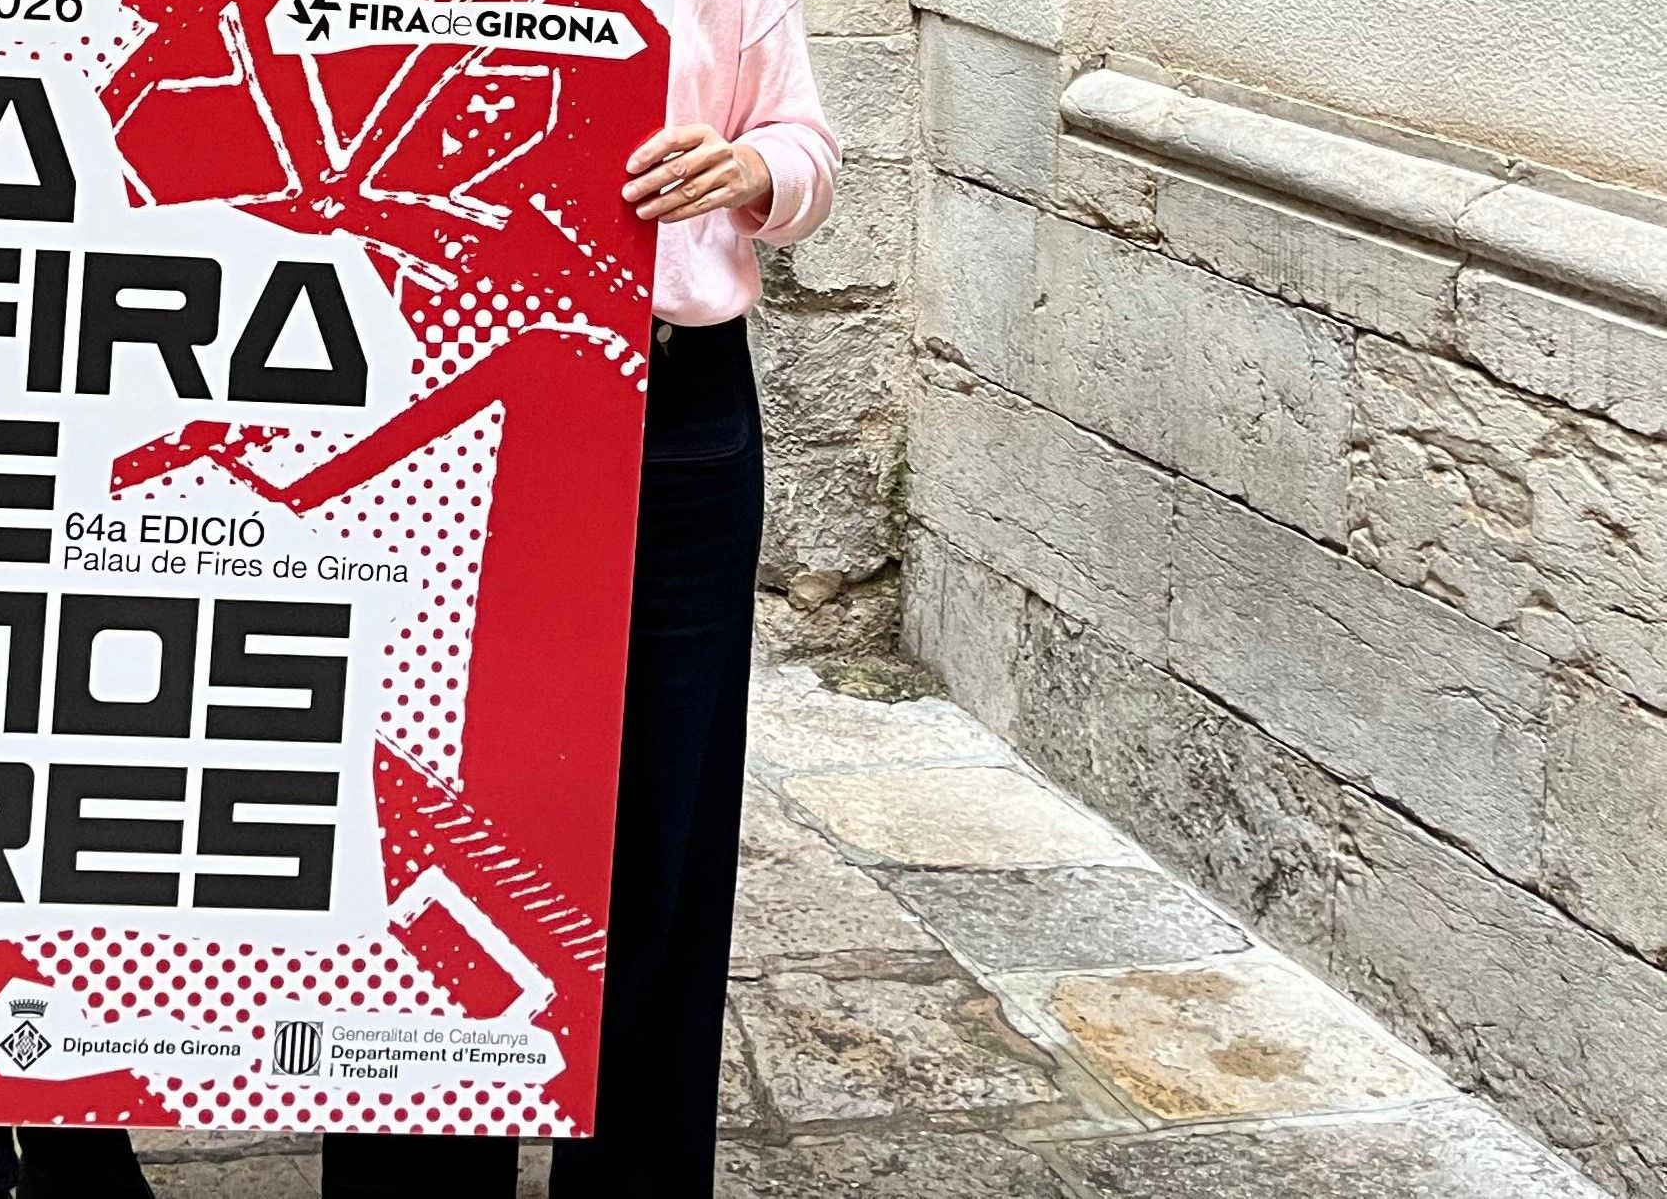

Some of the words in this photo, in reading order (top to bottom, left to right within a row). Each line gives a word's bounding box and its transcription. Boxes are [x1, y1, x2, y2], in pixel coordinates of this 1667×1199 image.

[65, 512, 127, 542] 64a
[140, 511, 265, 548] EDICIÓ
[64, 546, 141, 572] Palau
[151, 550, 186, 574] de
[197, 551, 263, 577] Fires
[273, 554, 307, 579] de
[317, 556, 409, 583] Girona
[63, 1037, 148, 1056] Diputació
[154, 1039, 176, 1055] de
[181, 1040, 241, 1056] Girona
[332, 1026, 418, 1043] Generalitat
[424, 1028, 444, 1043] de
[449, 1029, 528, 1048] Catalunya
[330, 1045, 447, 1062] Departament
[452, 1048, 546, 1066] d'Empresa
[340, 1063, 398, 1079] Treball
